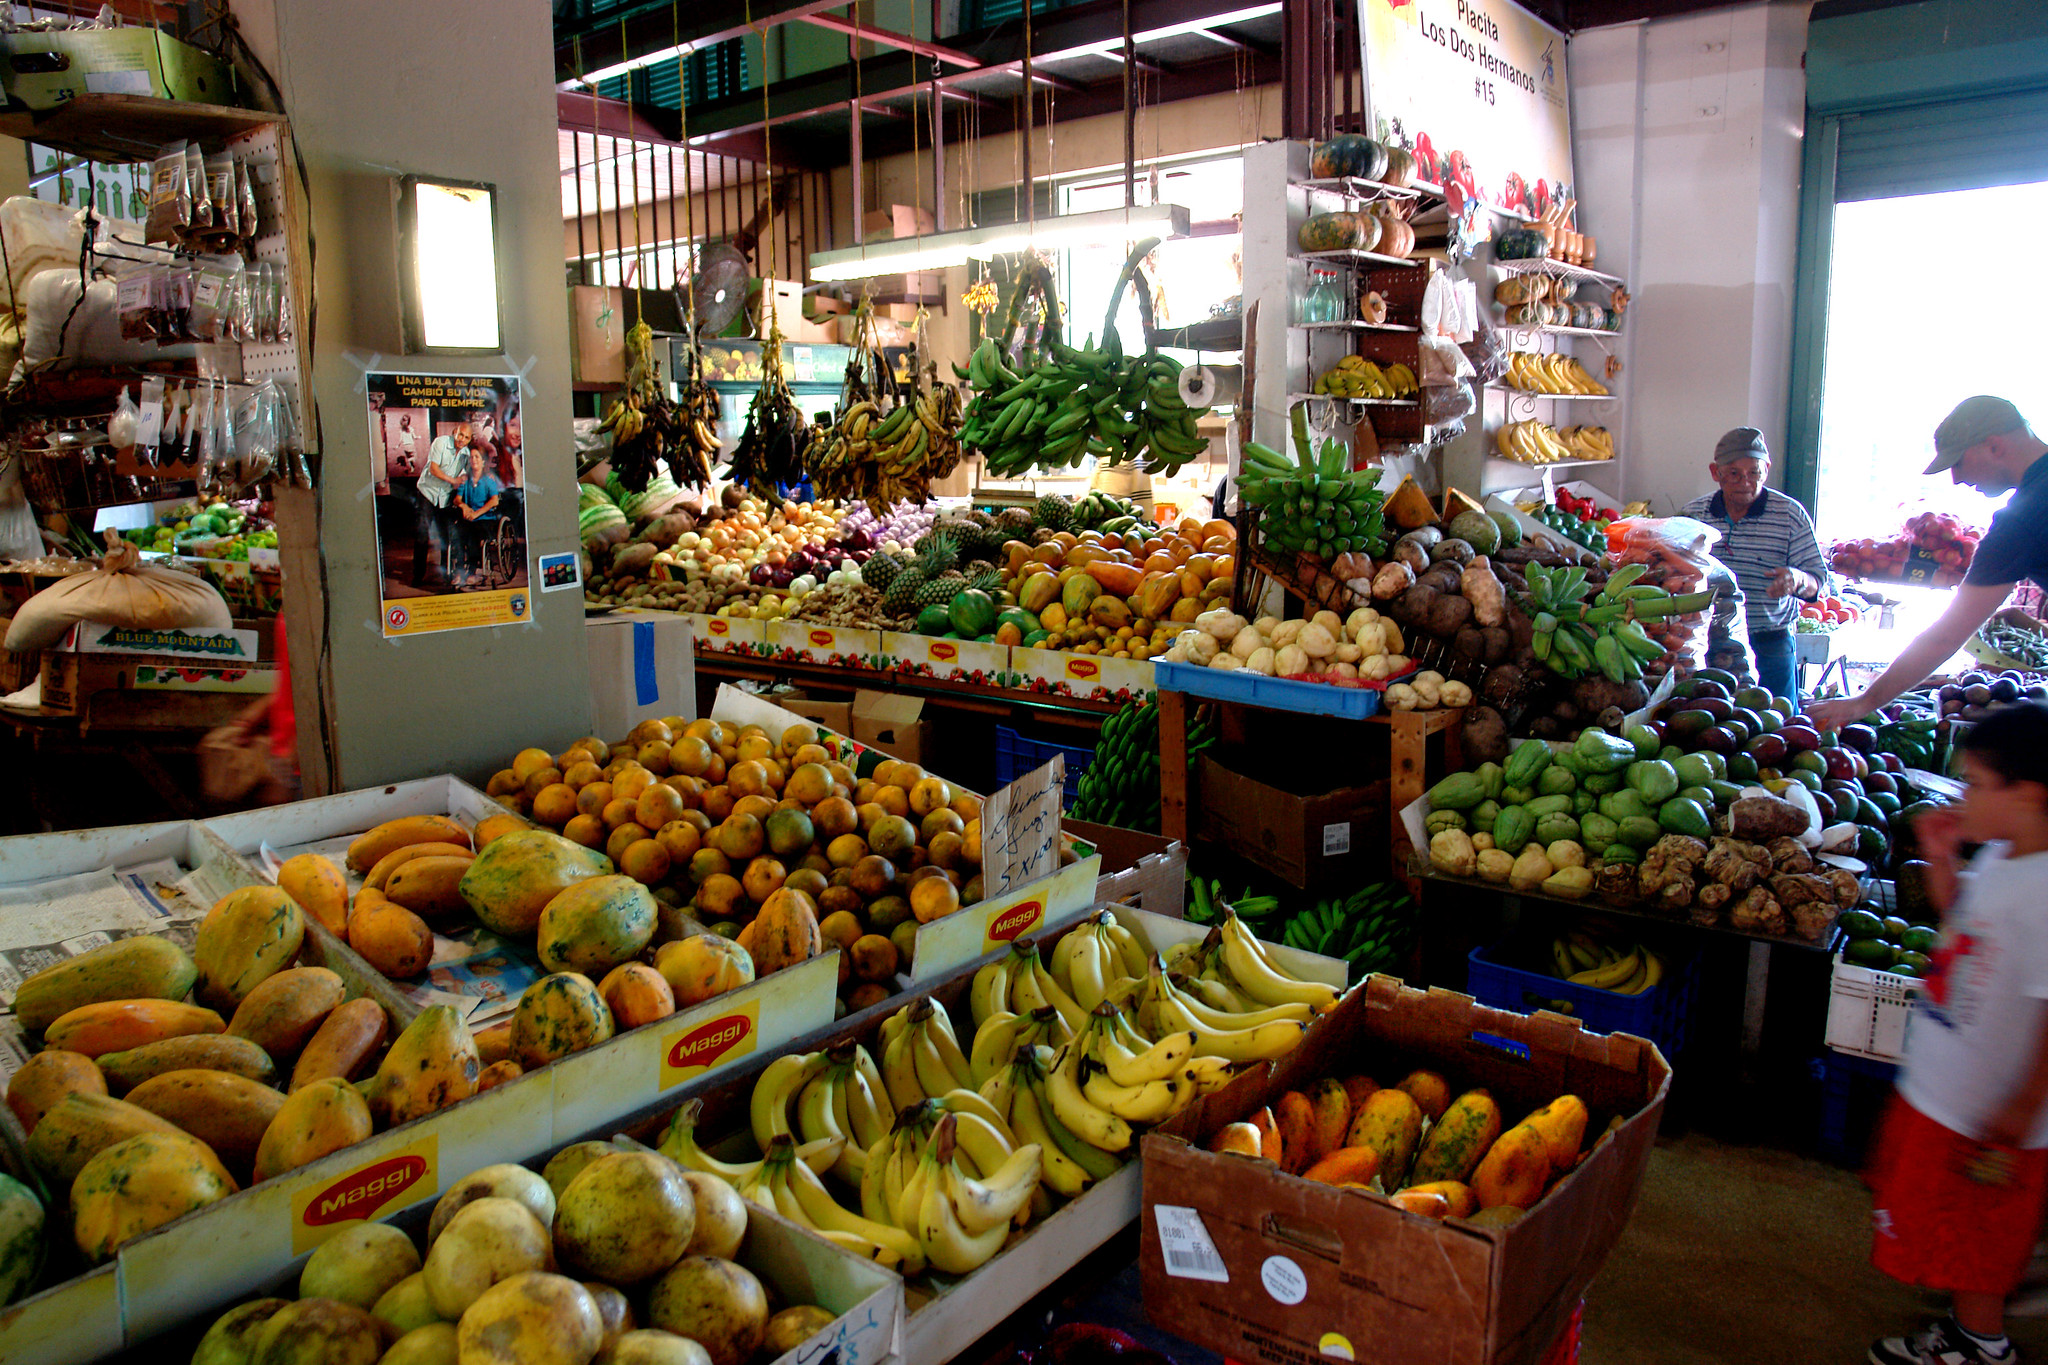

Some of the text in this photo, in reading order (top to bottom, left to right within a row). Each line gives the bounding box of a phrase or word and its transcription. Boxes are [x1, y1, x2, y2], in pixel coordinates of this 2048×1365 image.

[1457, 0, 1499, 43] Placita
[1420, 11, 1536, 94] Los Dos Hermanos
[1474, 76, 1496, 106] #15
[396, 375, 493, 388] UNA BALA AL AIRE
[402, 385, 488, 398] CAMBIÓ SU VIDA
[410, 398, 486, 408] PARA SIEMPRE
[115, 632, 154, 643] BLUE
[157, 634, 233, 649] MOUNTAIN
[1070, 663, 1095, 673] Maggi
[995, 906, 1036, 935] Maggi
[679, 1021, 741, 1060] Maggi
[320, 1163, 411, 1217] Maggi
